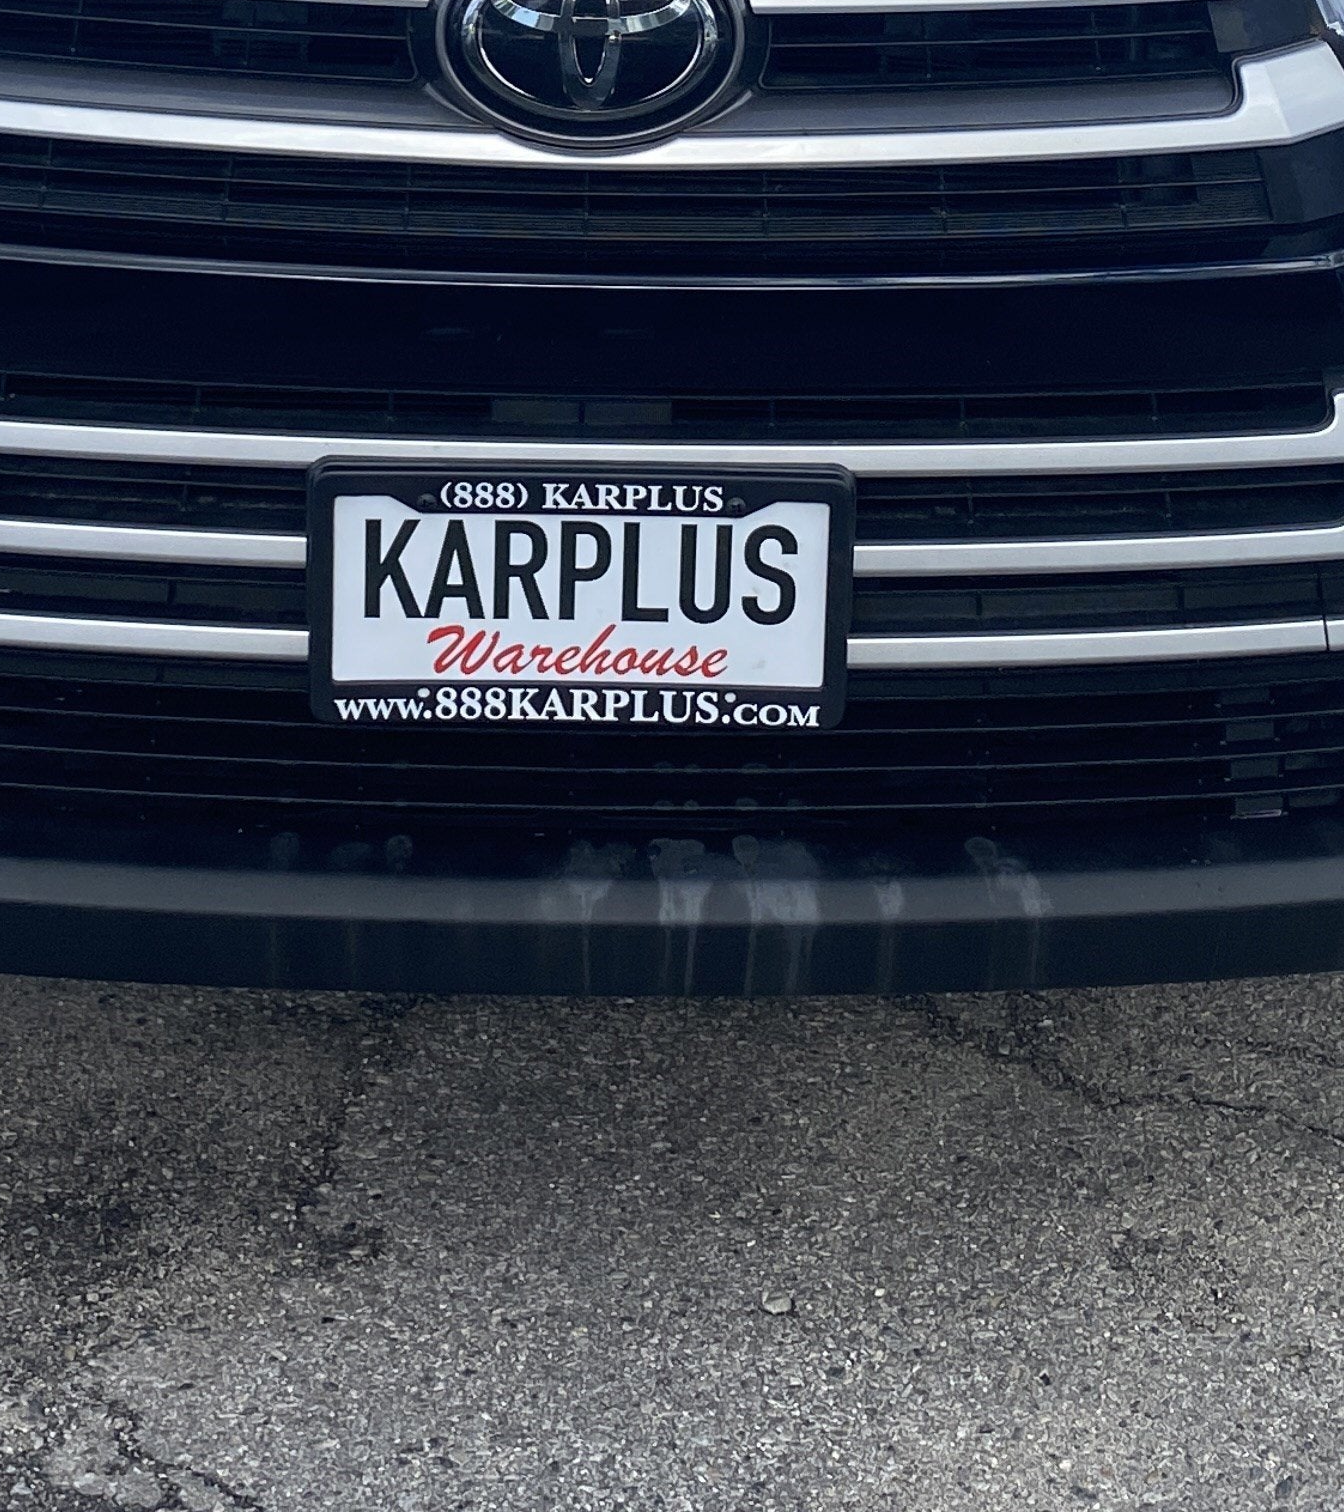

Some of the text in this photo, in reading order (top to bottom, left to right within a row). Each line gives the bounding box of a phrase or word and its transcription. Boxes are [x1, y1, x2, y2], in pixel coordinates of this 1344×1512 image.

[440, 481, 724, 513] (888) KARPLUS
[363, 517, 799, 627] KARPLUS
[427, 623, 729, 679] Warehouse
